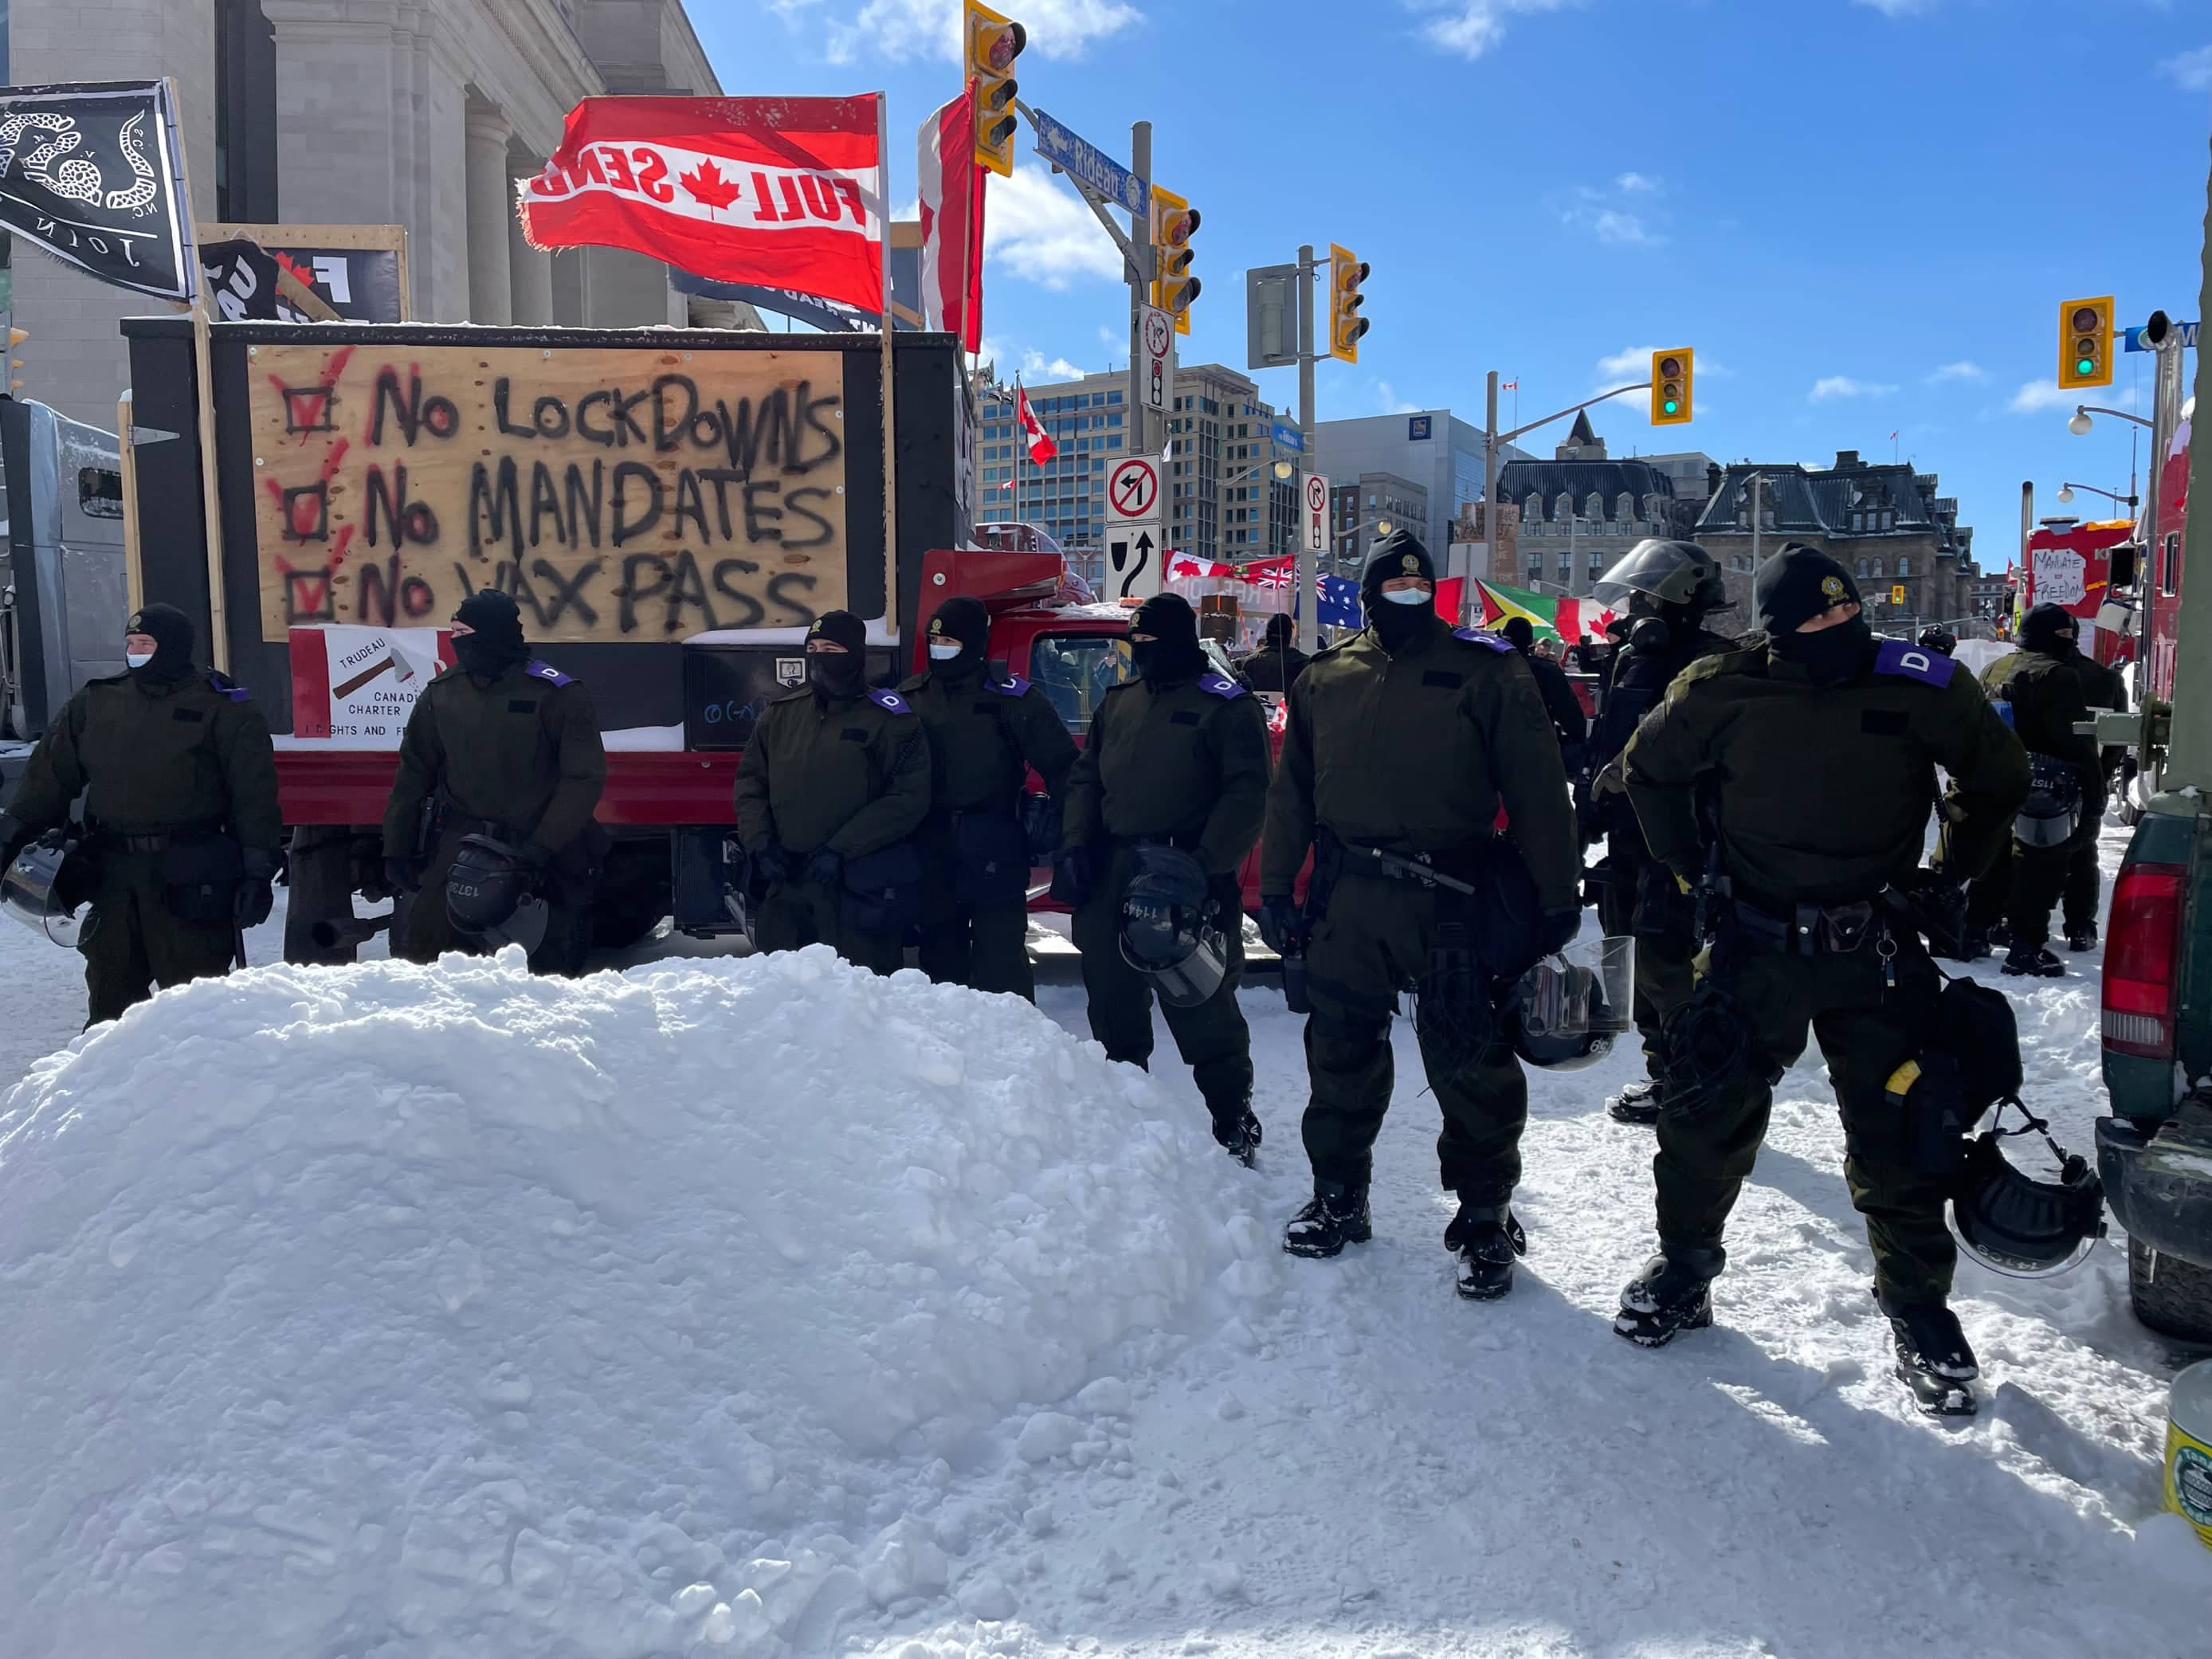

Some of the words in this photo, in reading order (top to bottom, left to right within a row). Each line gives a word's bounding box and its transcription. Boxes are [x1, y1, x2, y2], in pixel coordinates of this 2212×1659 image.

[1075, 139, 1119, 198] Rideau
[468, 455, 836, 560] MANDATES
[618, 550, 821, 634] PASS
[2033, 580, 2084, 601] FREEDOM
[339, 637, 386, 669] TRUDEAU
[1900, 652, 1930, 672] D
[348, 704, 401, 716] CHARTER
[881, 696, 900, 707] D
[363, 726, 386, 735] AND
